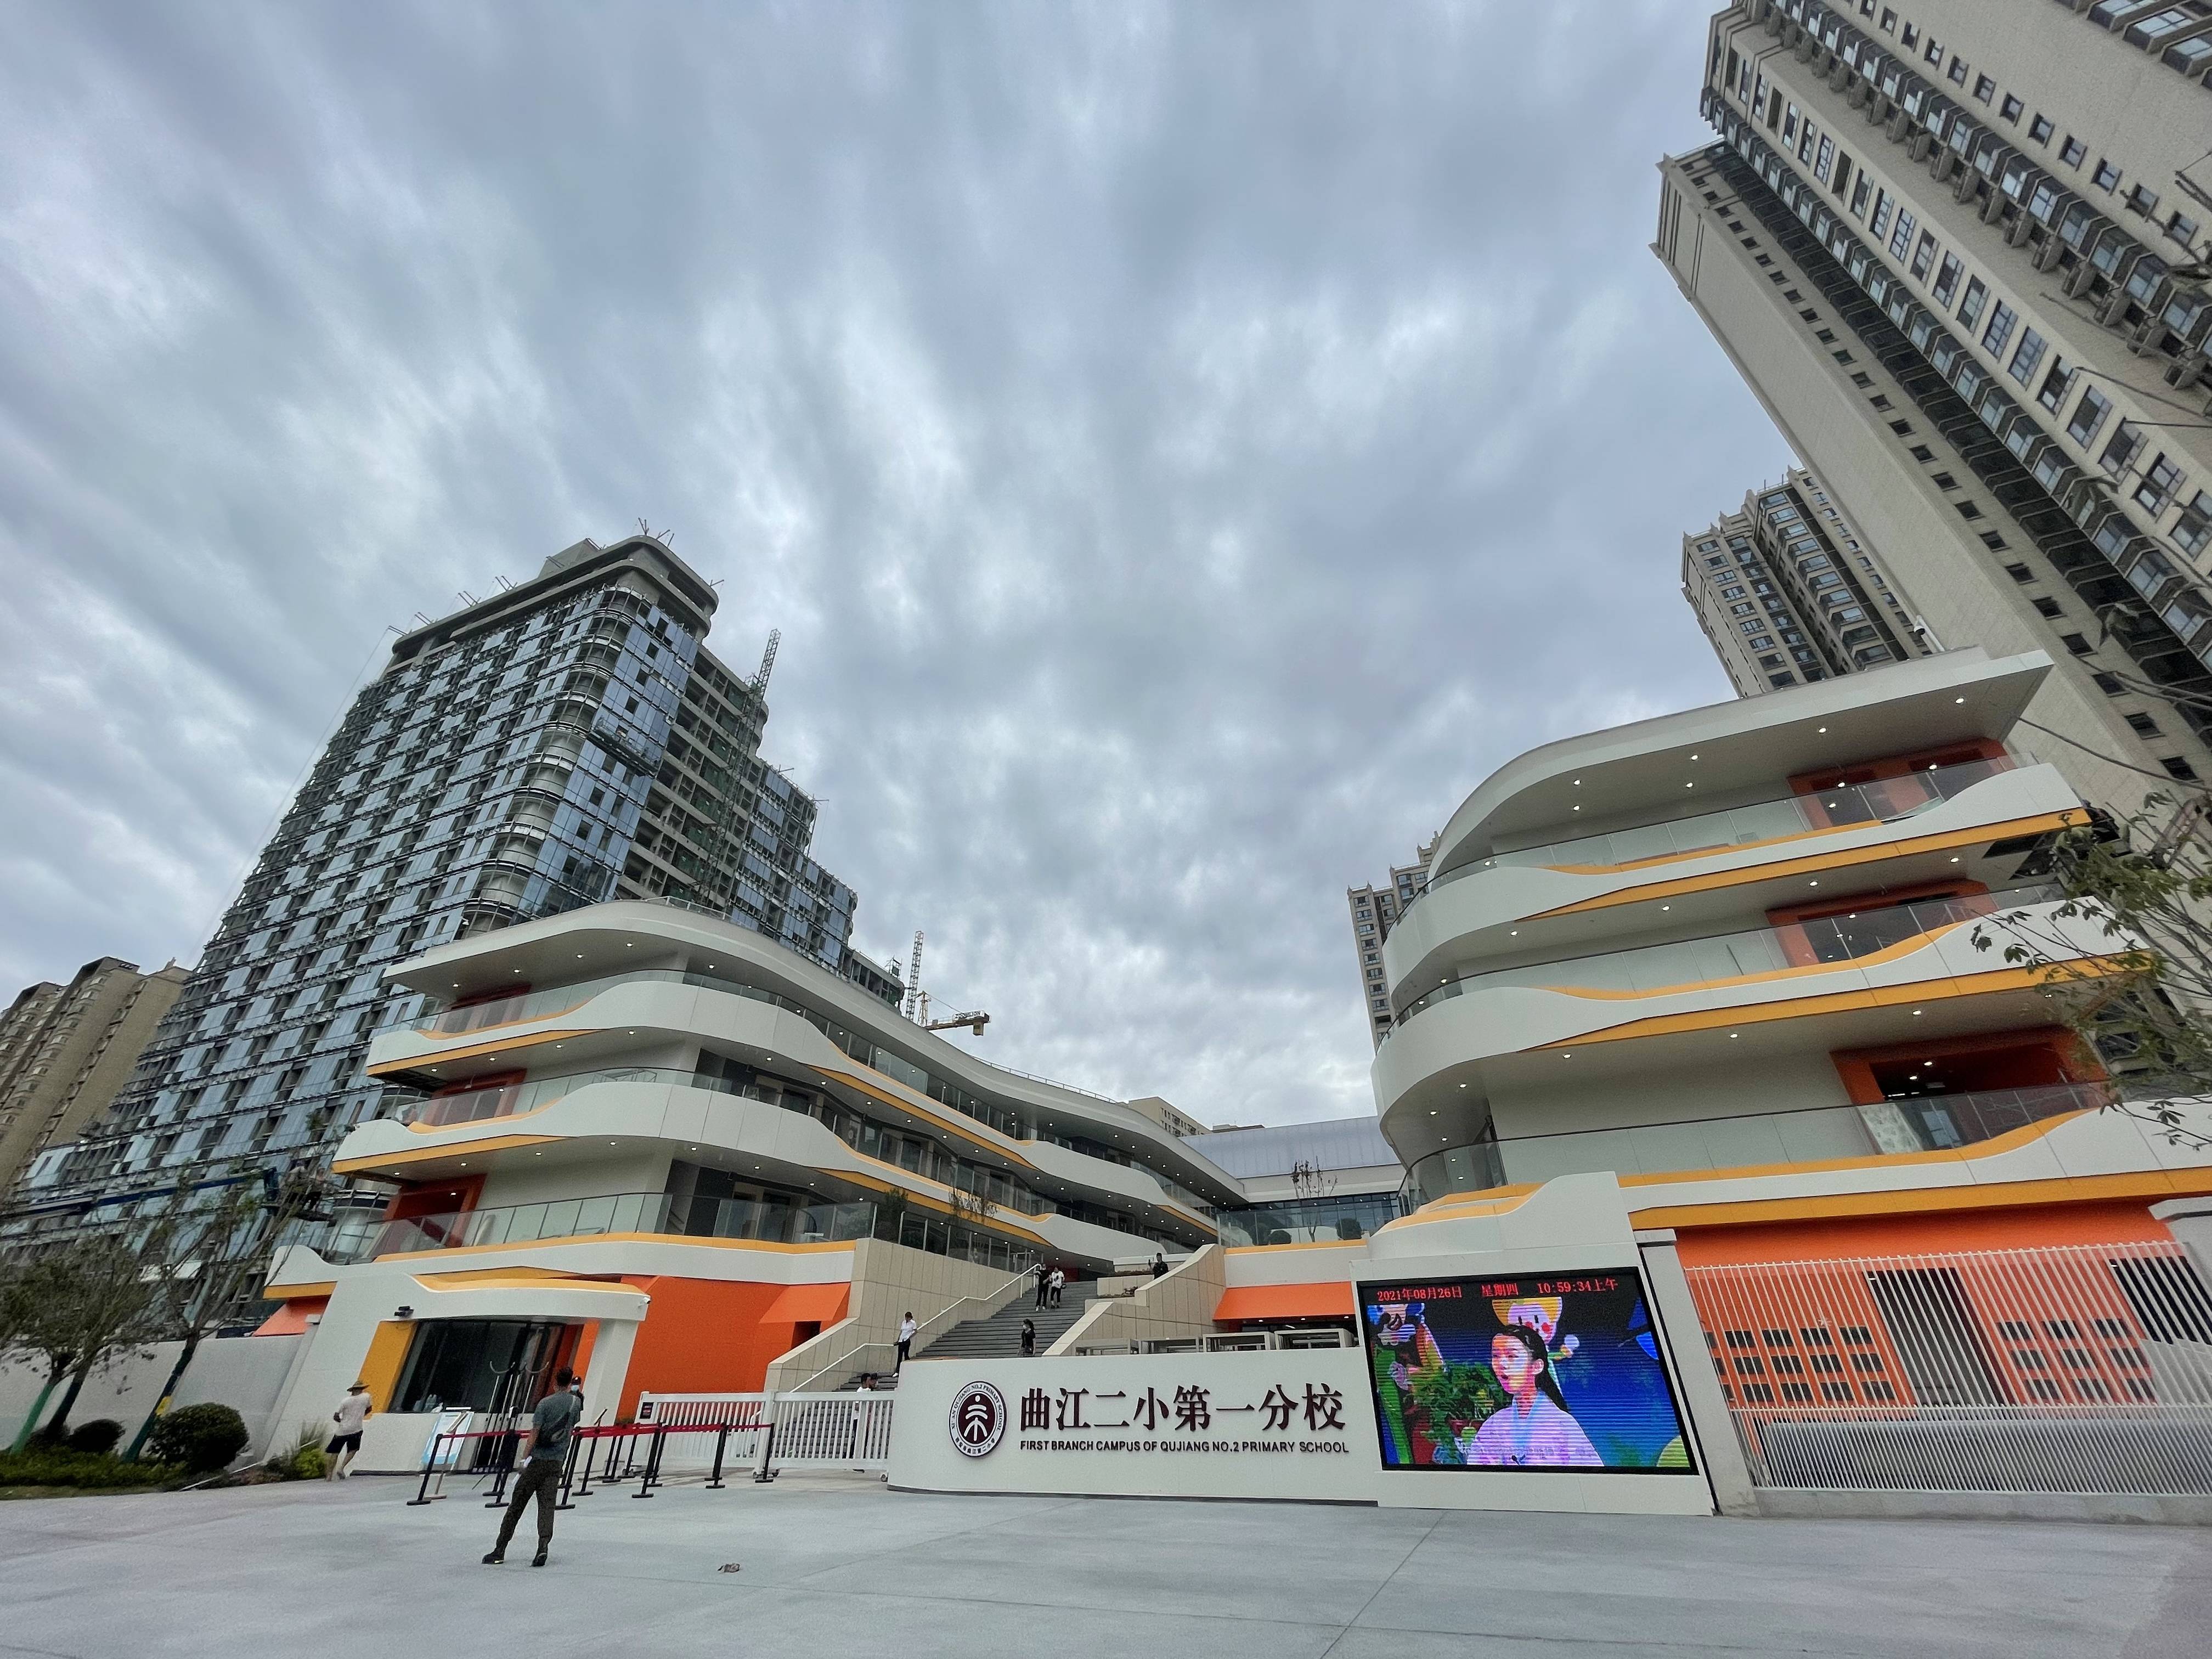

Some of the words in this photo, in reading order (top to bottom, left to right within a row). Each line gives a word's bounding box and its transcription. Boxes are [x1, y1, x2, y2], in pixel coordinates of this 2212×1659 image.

[1378, 1286, 1463, 1301] 2021年08月26日
[1482, 1282, 1519, 1297] 星期四
[983, 1385, 1000, 1403] PRIMARY
[1020, 1383, 1346, 1431] 曲江二小第一分校
[1020, 1440, 1049, 1451] FIRST
[1051, 1440, 1093, 1451] BRANCH
[1096, 1440, 1141, 1452] CAMPUS
[1143, 1441, 1158, 1451] OF
[1160, 1441, 1209, 1452] QUJIANG
[1212, 1441, 1239, 1452] NO.2
[1242, 1441, 1295, 1452] PRIMARY
[1299, 1441, 1349, 1453] SCHOOL
